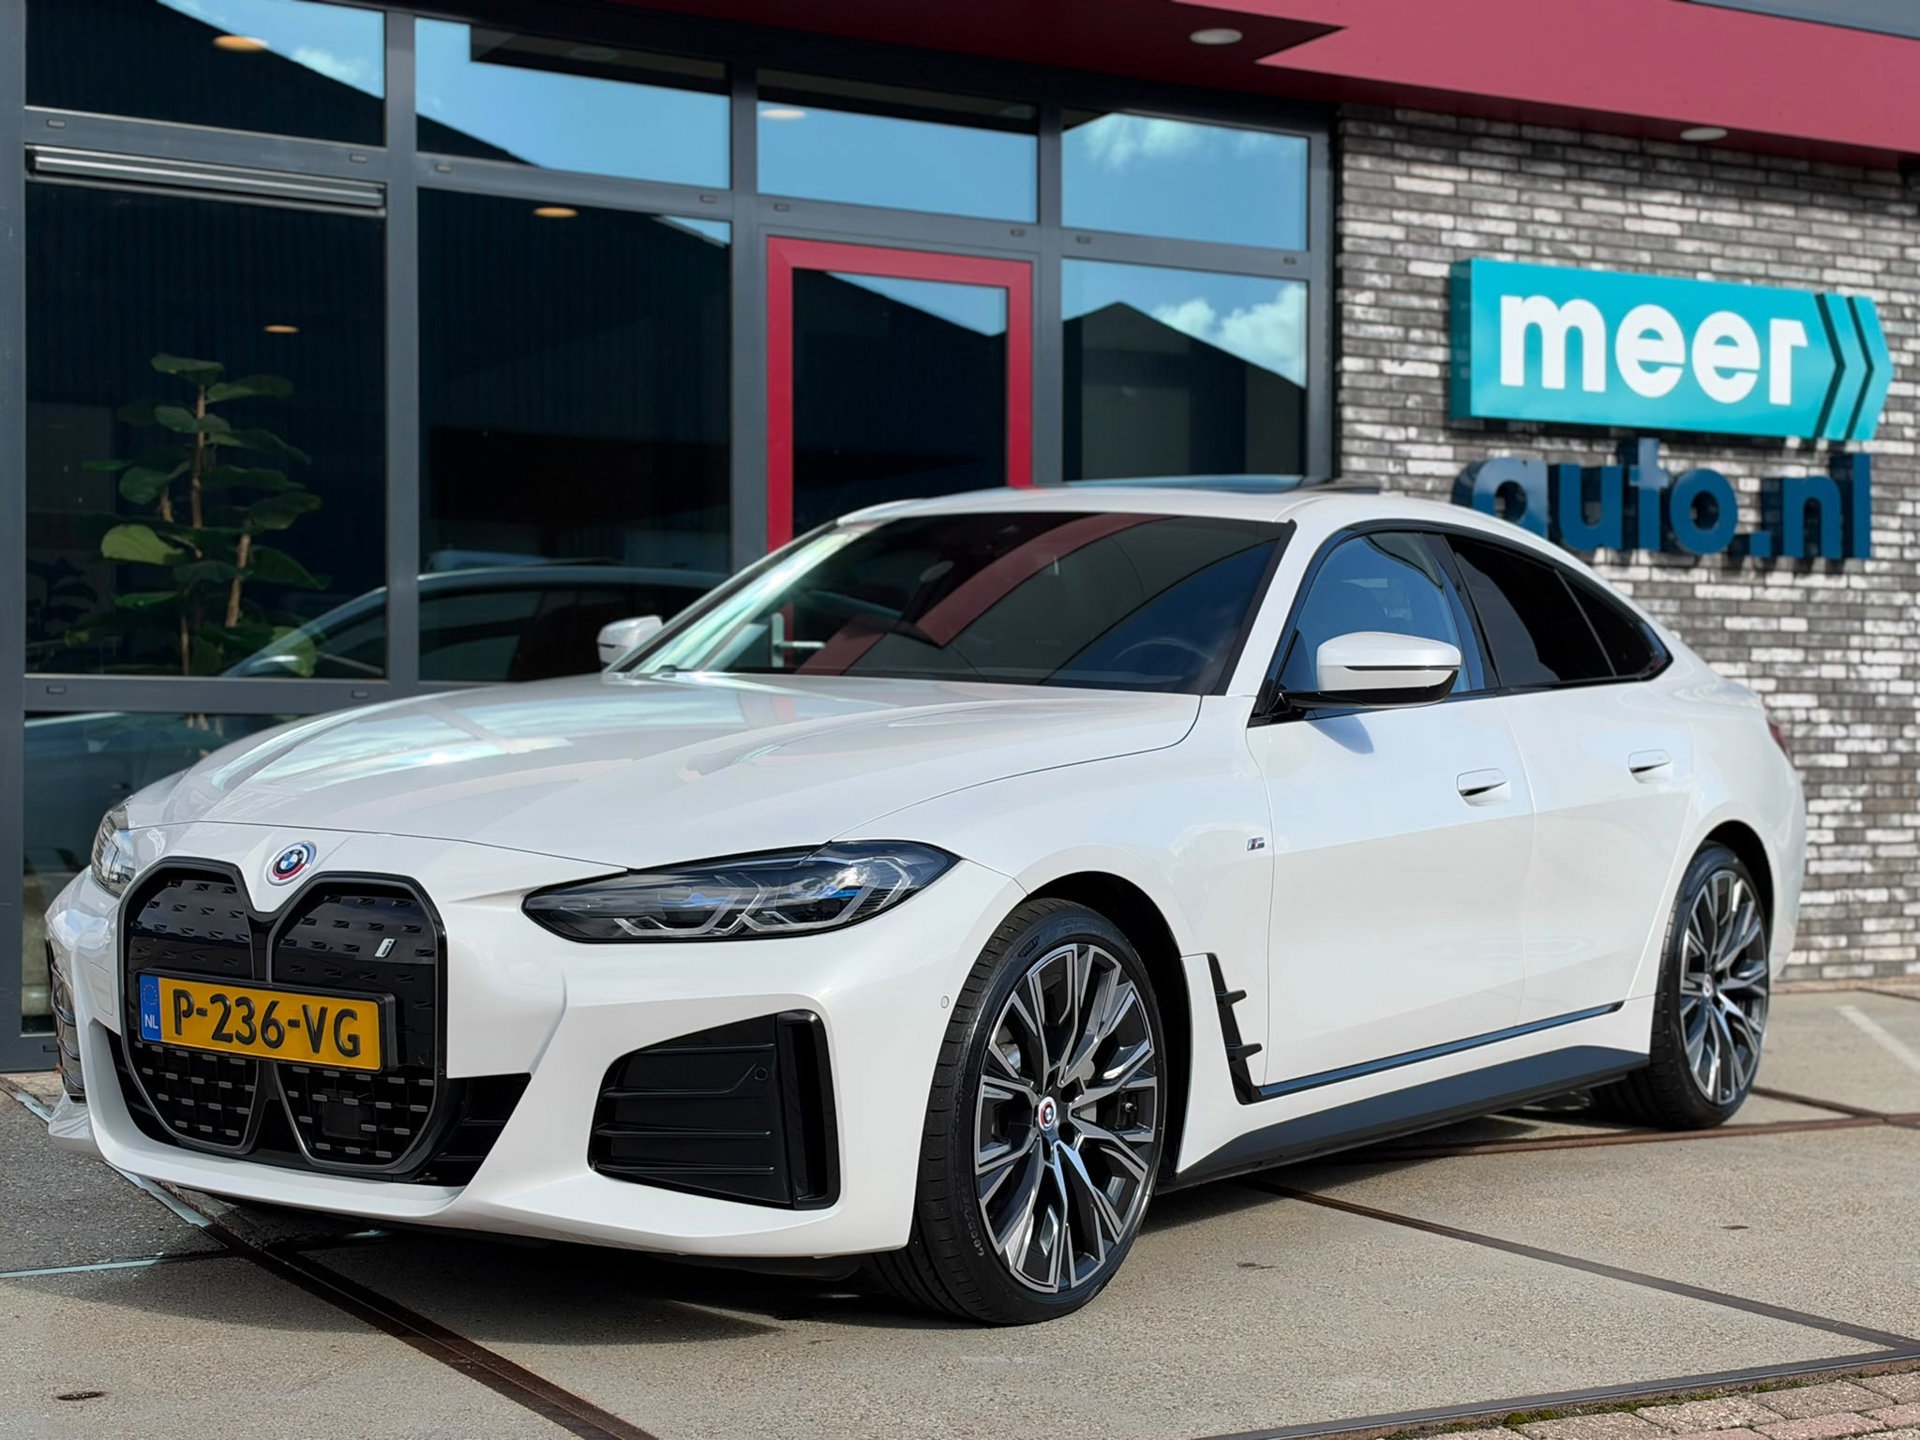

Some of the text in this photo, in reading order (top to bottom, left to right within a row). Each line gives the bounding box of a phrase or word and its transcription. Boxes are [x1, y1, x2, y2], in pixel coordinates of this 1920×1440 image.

[1501, 294, 1808, 406] meer
[1472, 437, 1871, 559] auto.nl
[144, 1013, 159, 1030] NL
[172, 988, 361, 1058] P-236-VG
